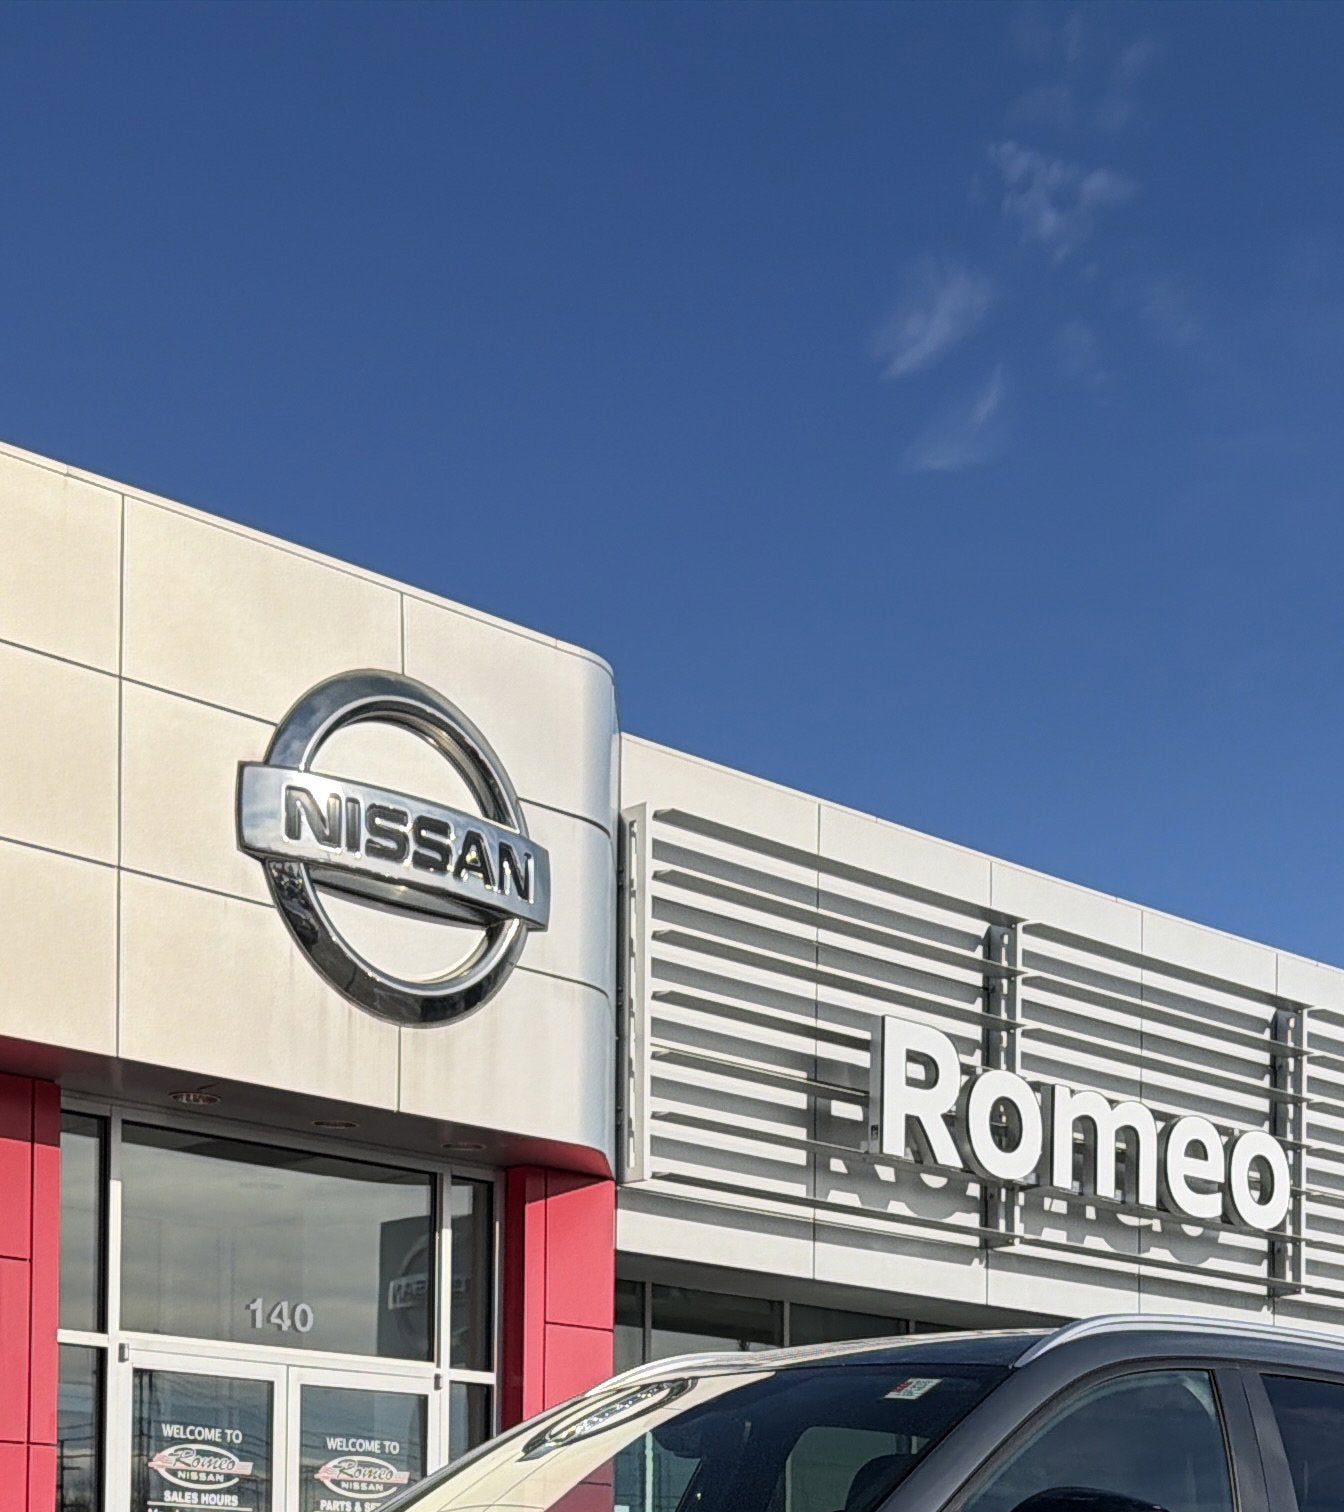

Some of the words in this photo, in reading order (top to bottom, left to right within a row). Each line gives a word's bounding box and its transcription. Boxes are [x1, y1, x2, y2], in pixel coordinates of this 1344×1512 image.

[282, 783, 536, 905] NISSAN
[874, 1014, 1292, 1231] Romeo
[249, 1297, 315, 1333] 140
[161, 1423, 222, 1442] WELCOME
[224, 1429, 243, 1444] TO
[325, 1436, 381, 1454] WELCOME
[383, 1440, 401, 1455] TO
[168, 1447, 236, 1470] Romeo
[177, 1470, 225, 1482] NISSAN
[333, 1459, 394, 1480] Romeo
[340, 1481, 384, 1492] NISSAN
[163, 1489, 199, 1504] SALES
[201, 1493, 239, 1506] HOURS
[319, 1499, 352, 1512] PARTS
